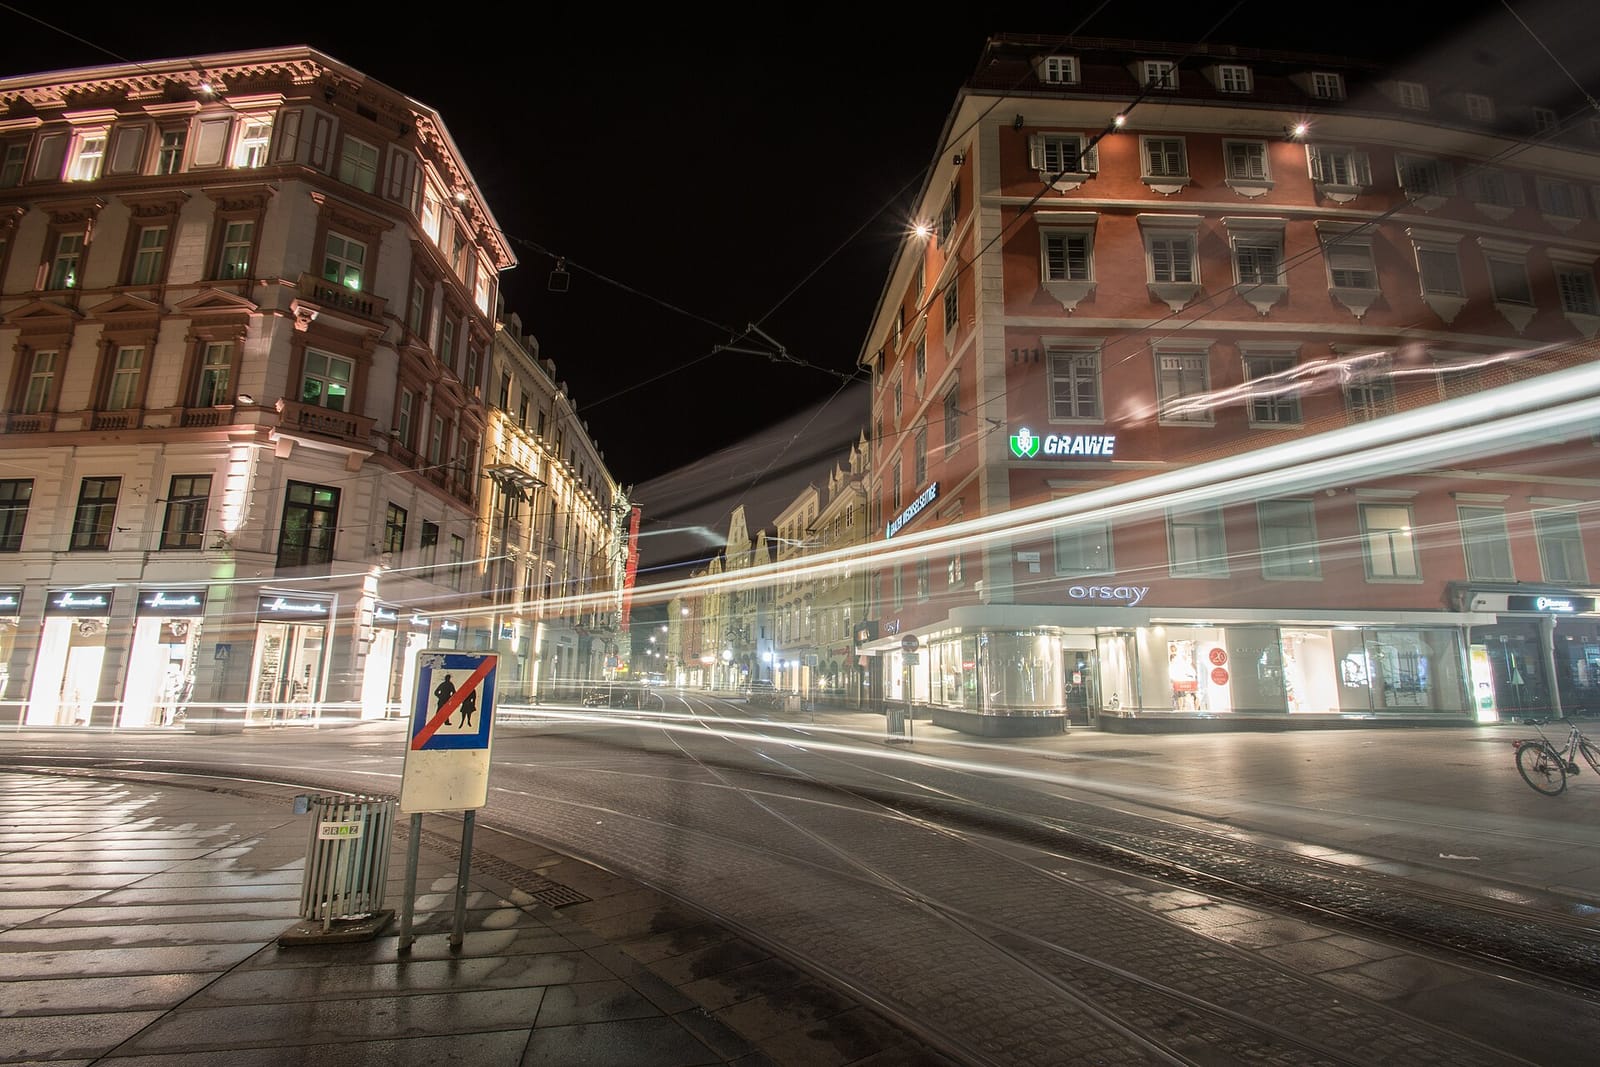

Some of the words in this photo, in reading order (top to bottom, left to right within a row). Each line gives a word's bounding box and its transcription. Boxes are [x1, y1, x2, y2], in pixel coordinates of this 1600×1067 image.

[1011, 348, 1040, 363] 111
[1043, 435, 1116, 456] GRAWE
[1068, 584, 1149, 607] orsay
[322, 826, 359, 836] GRAZ
